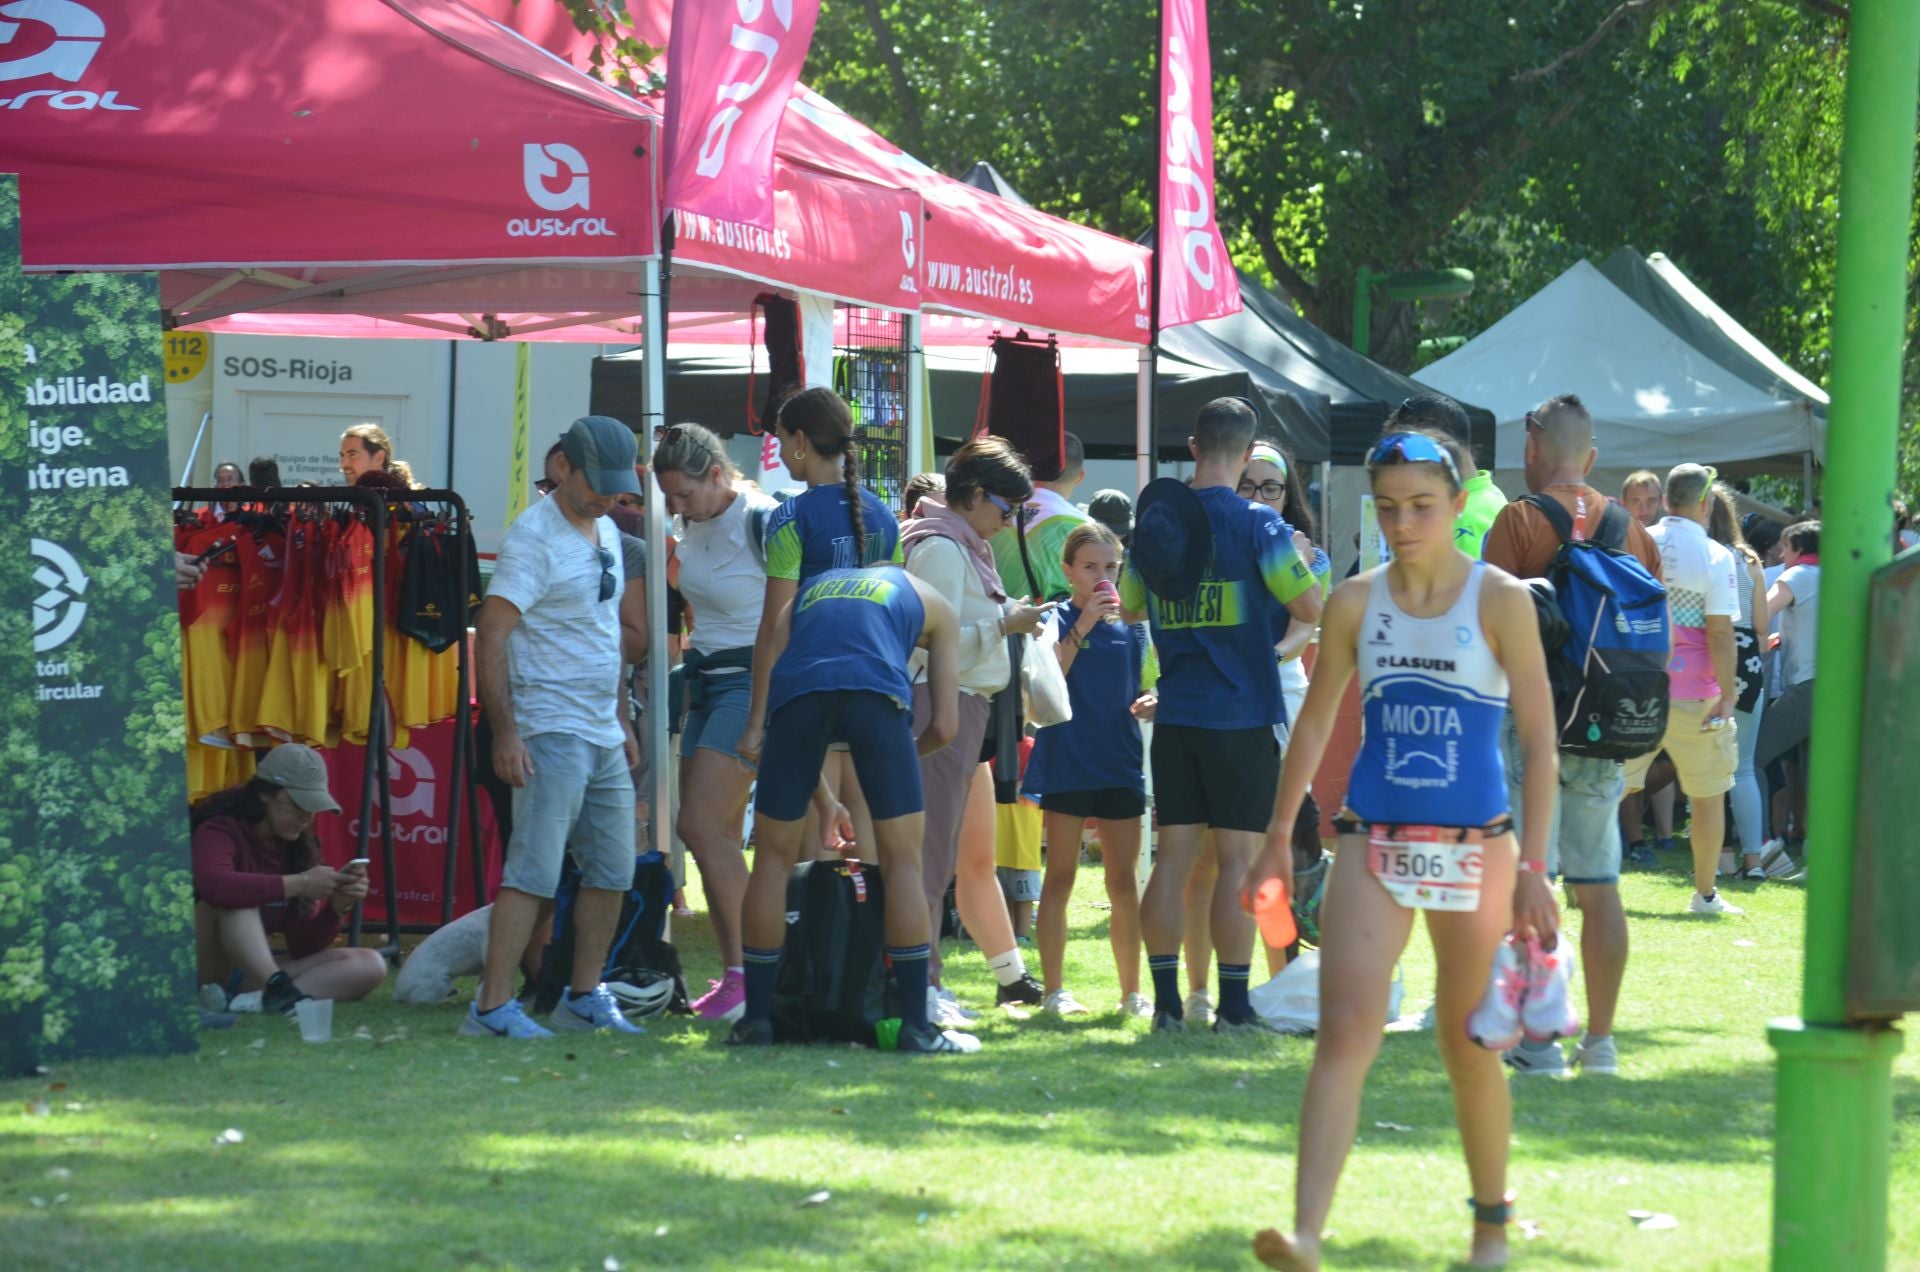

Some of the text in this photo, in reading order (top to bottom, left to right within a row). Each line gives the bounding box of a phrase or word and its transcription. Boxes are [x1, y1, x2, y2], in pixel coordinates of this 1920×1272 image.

[506, 217, 617, 237] austral
[927, 261, 1033, 304] www.austral.es
[167, 337, 202, 356] 112
[223, 356, 352, 385] SOS-Rioja
[27, 419, 93, 455] ige.
[35, 682, 104, 700] ircular
[1382, 703, 1463, 736] MIOTA
[1378, 851, 1445, 878] 1506
